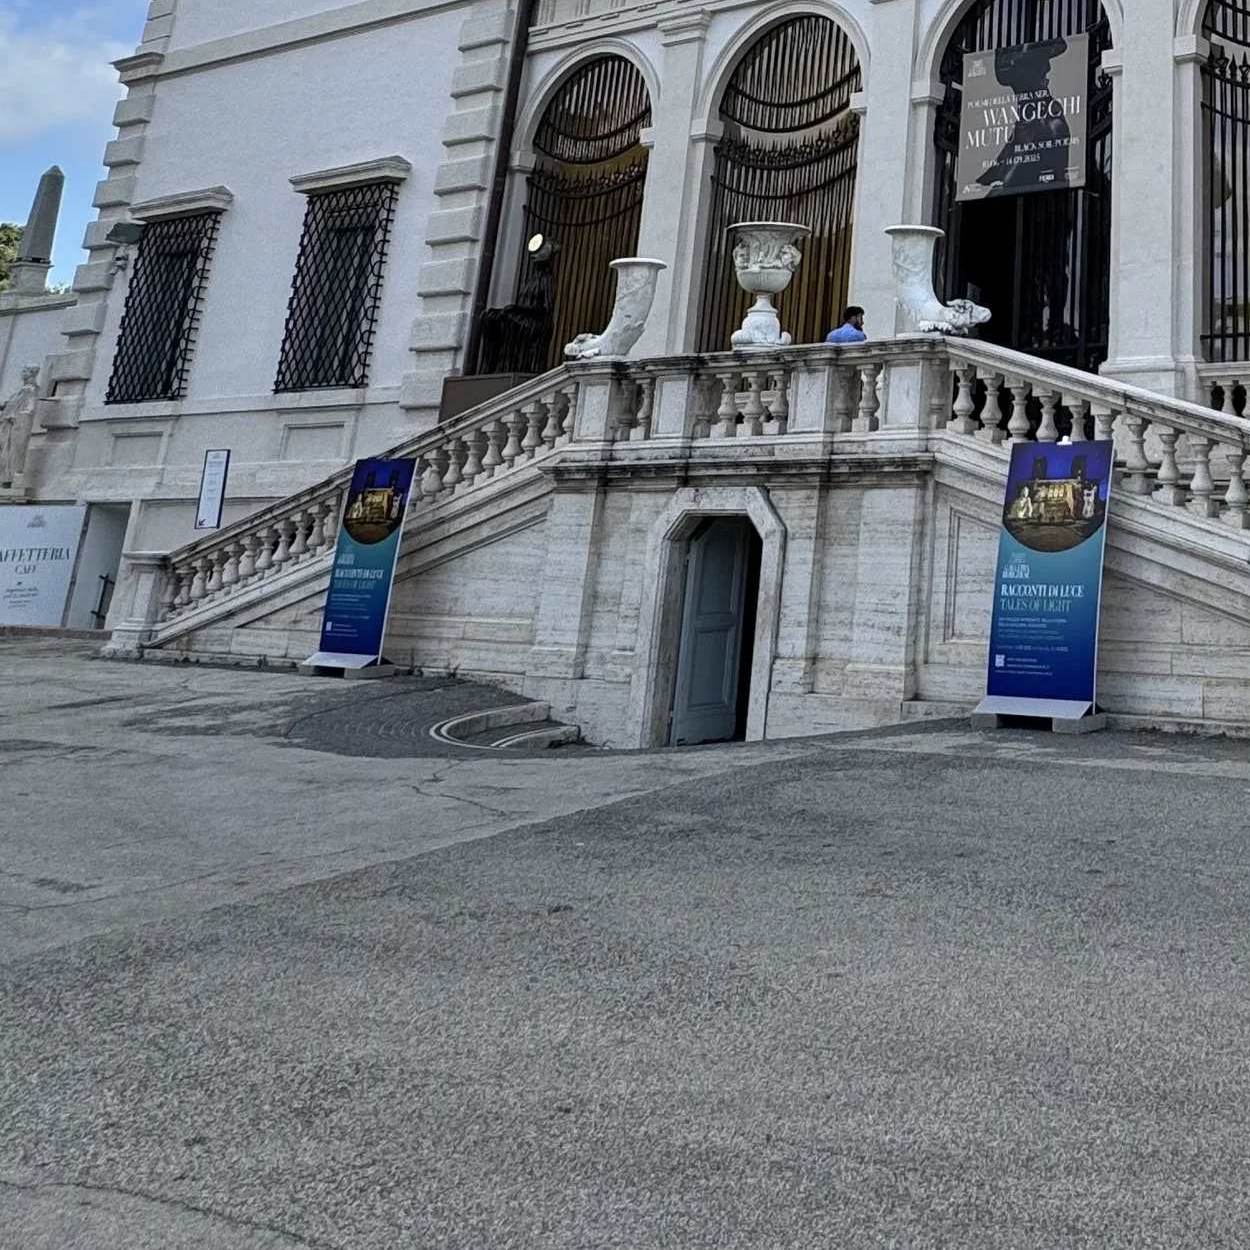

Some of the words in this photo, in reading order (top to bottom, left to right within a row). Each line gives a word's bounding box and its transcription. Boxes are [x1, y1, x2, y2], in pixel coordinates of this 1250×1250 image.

[983, 95, 1080, 126] WANGECHI
[966, 126, 1015, 149] MUTU
[1000, 583, 1047, 597] RACCONTI
[1048, 584, 1059, 597] DI
[1060, 584, 1085, 598] LUCE
[1000, 598, 1028, 611] TALES
[1029, 598, 1042, 611] OF
[1043, 599, 1072, 613] LIGHT
